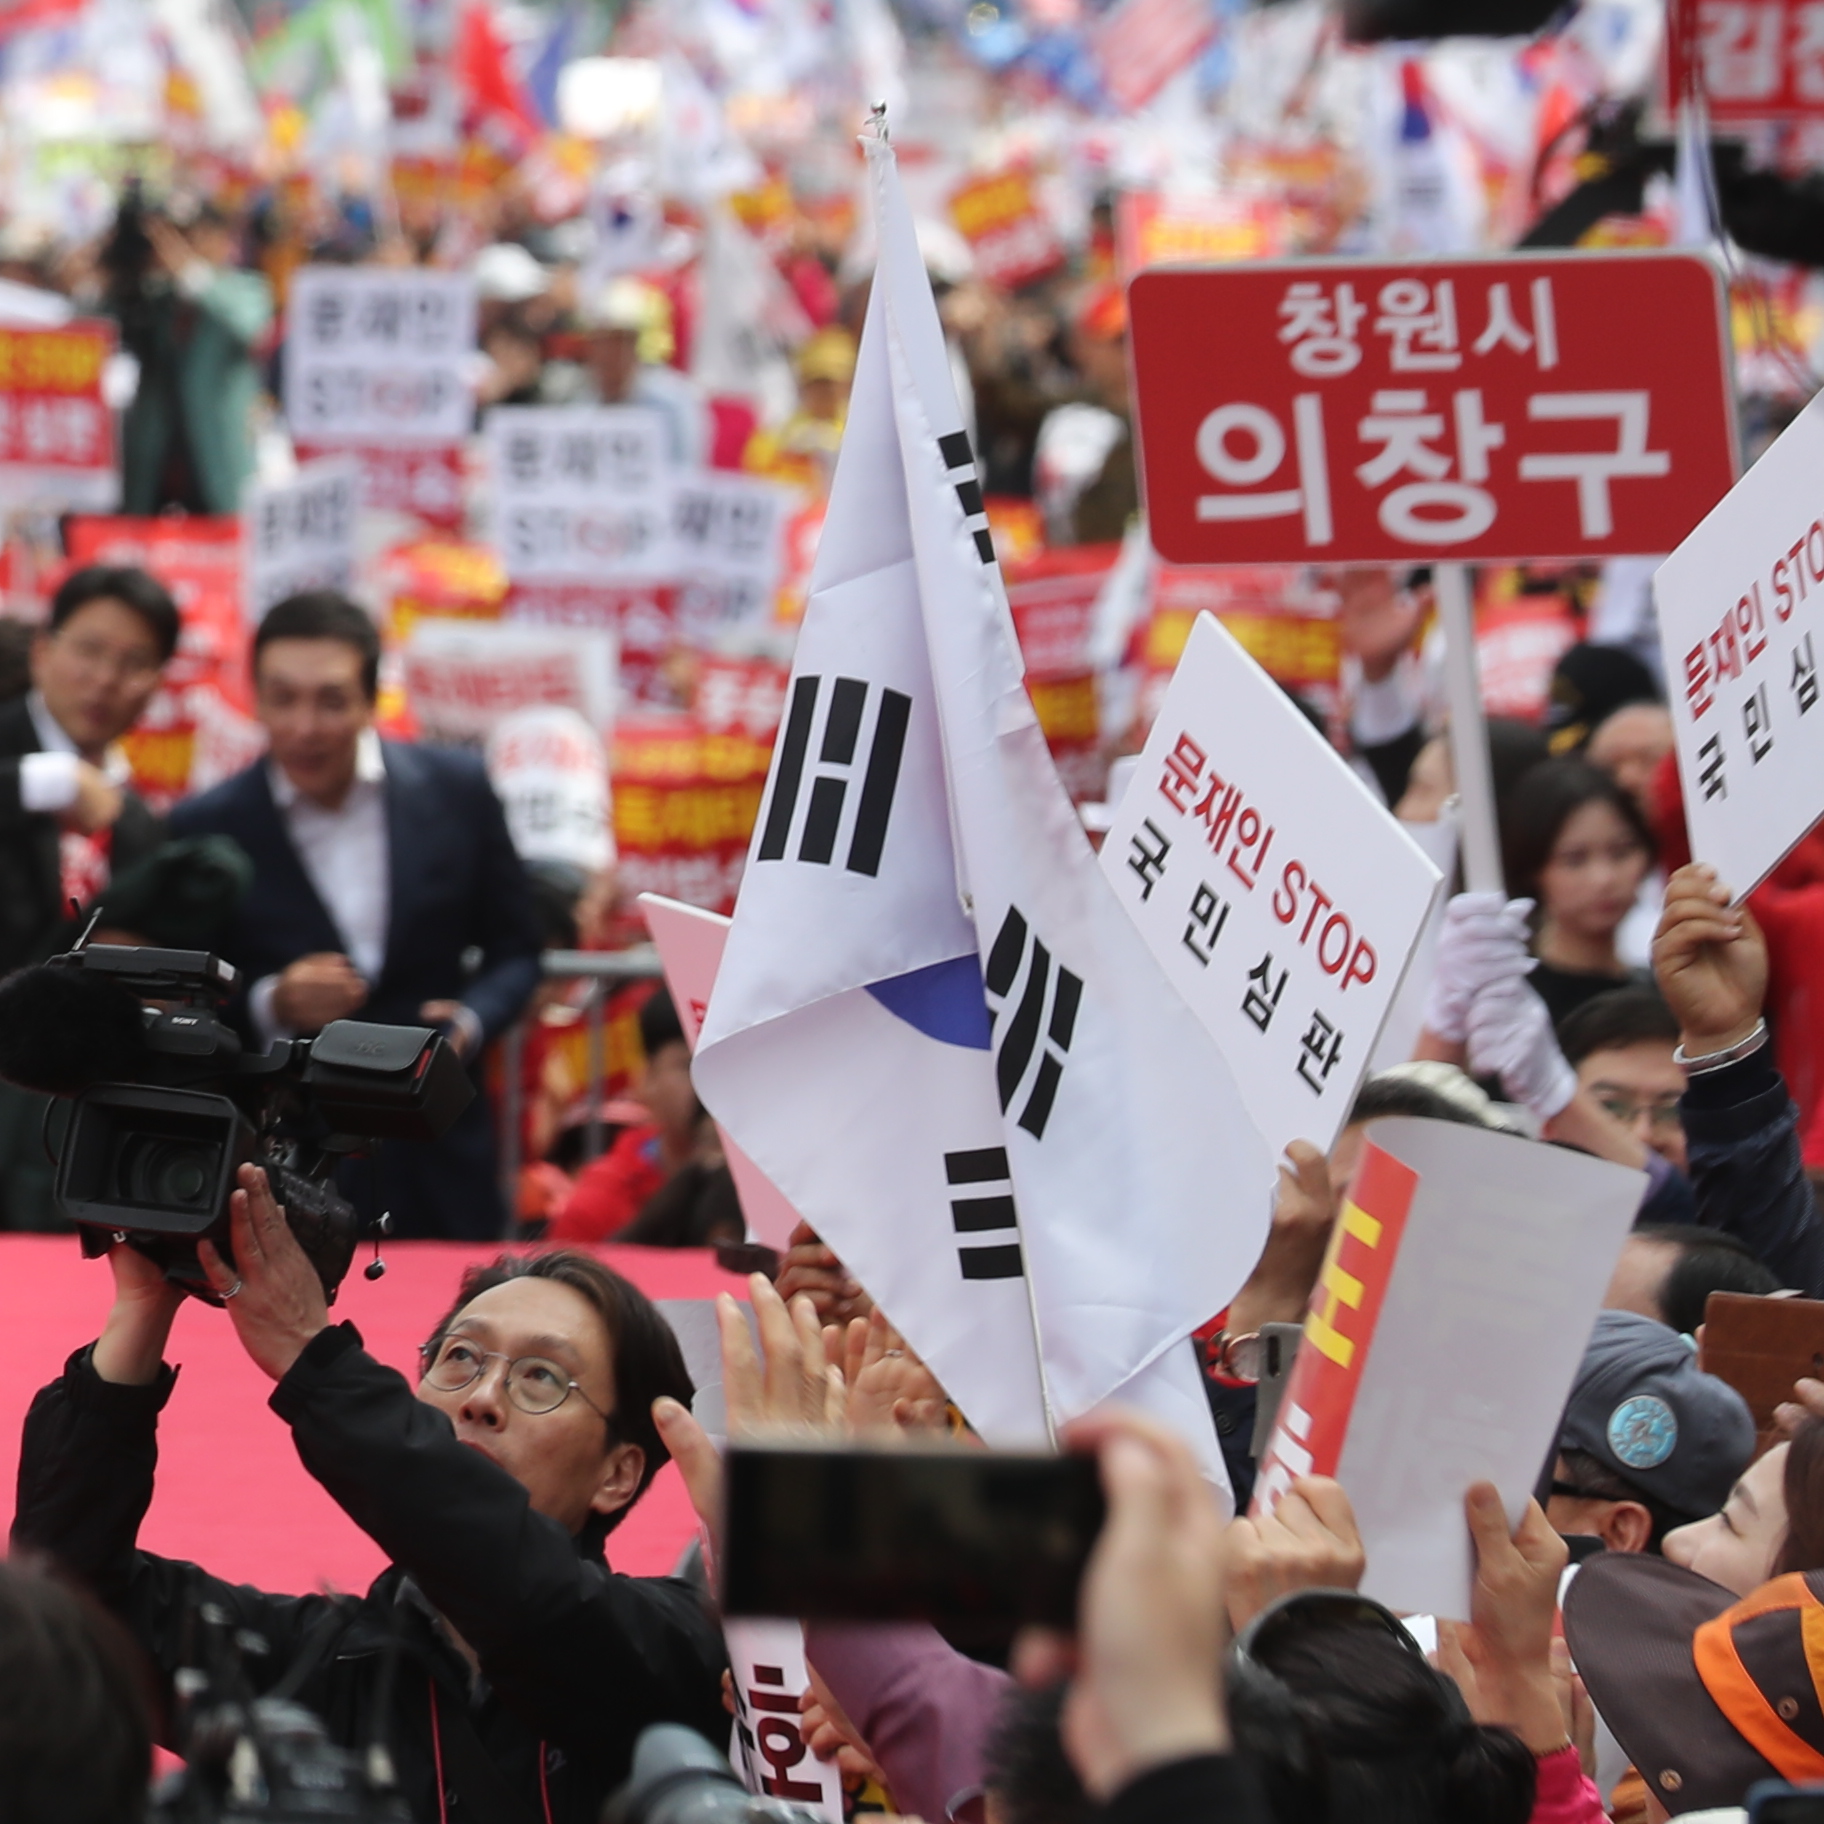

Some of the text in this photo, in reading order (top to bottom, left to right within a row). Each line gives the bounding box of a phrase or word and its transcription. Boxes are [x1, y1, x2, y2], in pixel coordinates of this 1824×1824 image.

[1276, 276, 1560, 379] 창원시
[1195, 387, 1671, 547] 의창구
[1683, 579, 1769, 724] 문재인
[1157, 729, 1276, 892] 문재인
[1271, 857, 1379, 993] STOP
